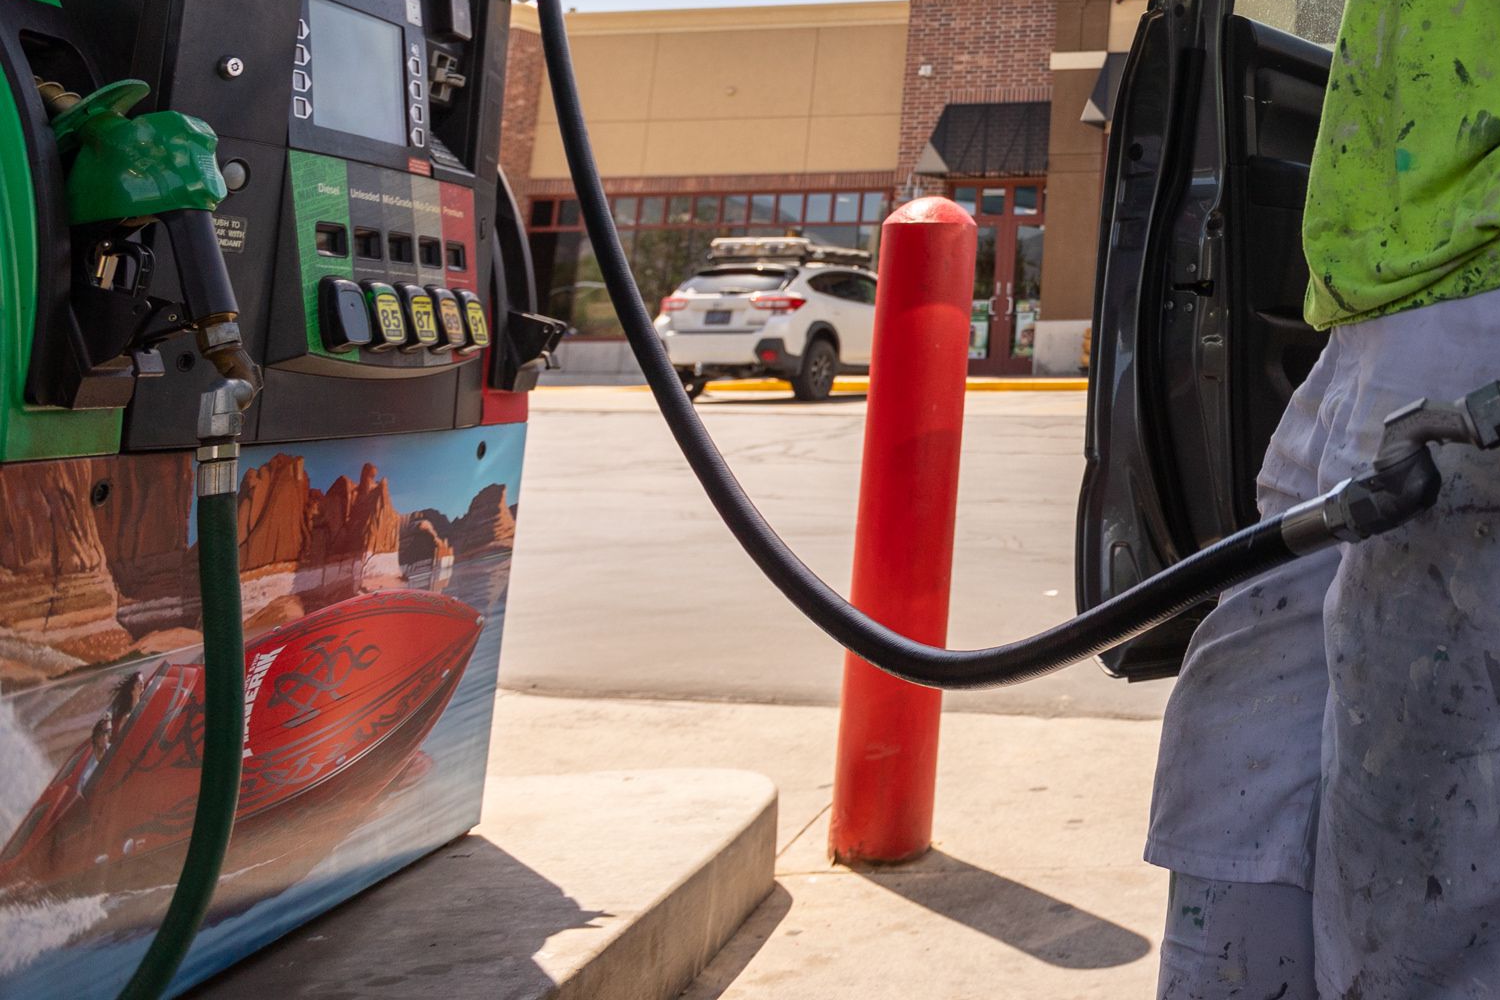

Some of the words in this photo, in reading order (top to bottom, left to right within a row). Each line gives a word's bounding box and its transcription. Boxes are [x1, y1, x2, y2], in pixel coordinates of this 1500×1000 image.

[318, 183, 340, 196] Diesel
[350, 188, 380, 202] Unleaded
[380, 309, 400, 328] 85
[415, 310, 430, 328] 87
[444, 312, 460, 330] 89
[471, 315, 486, 333] 91
